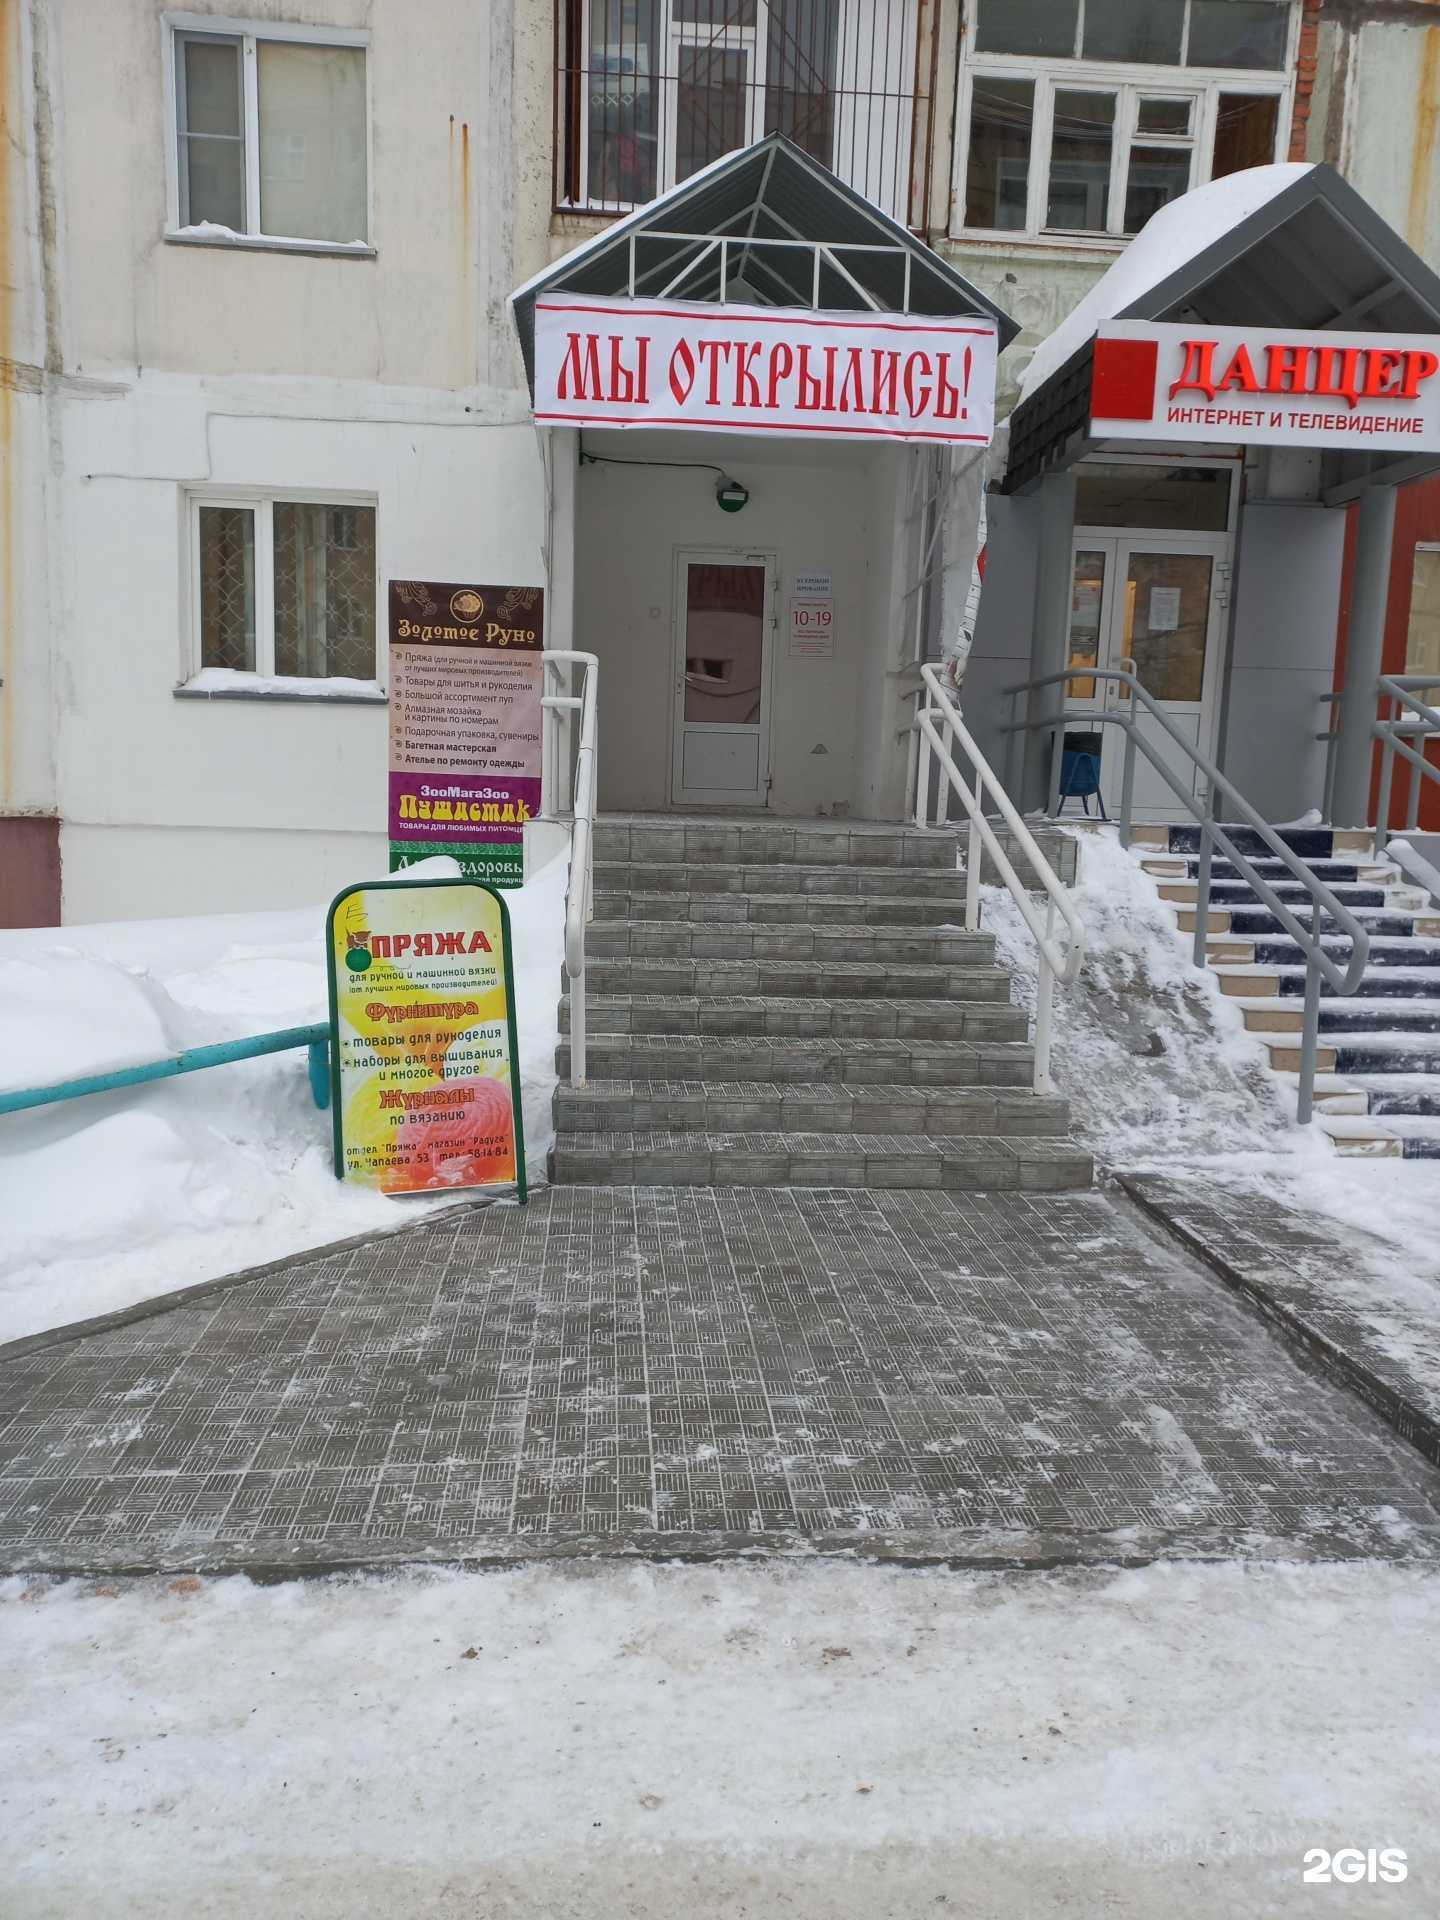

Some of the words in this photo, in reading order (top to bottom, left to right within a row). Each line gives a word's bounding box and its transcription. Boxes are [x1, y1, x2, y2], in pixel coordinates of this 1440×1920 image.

[557, 332, 651, 404] МЫ
[669, 337, 972, 420] ОТКРЫЛИСЬ!
[1168, 340, 1439, 410] ДАНЦЕР
[1167, 407, 1264, 427] ИНТЕРНЕТ
[1269, 412, 1282, 428] И
[1288, 413, 1424, 434] ТЕЛЕВИДЕНИЕ
[793, 611, 832, 626] 10-19
[398, 619, 479, 641] Золотое
[485, 623, 535, 645] Руно
[405, 652, 432, 663] Пряжа
[405, 676, 435, 687] Товары
[437, 679, 452, 688] для
[489, 681, 532, 691] рукоделия
[405, 690, 442, 700] Большой
[444, 693, 497, 704] ассортимент
[405, 704, 445, 714] Алмазная
[412, 714, 447, 724] картины
[462, 718, 498, 726] номерам
[405, 727, 455, 738] Подарочная
[499, 733, 539, 742] сувениры
[405, 741, 444, 751] Багетная
[447, 744, 496, 754] мастерская
[405, 754, 435, 764] Ателье
[437, 757, 448, 765] по
[450, 758, 487, 768] ремонту
[489, 759, 525, 768] одежды
[421, 785, 510, 799] ЗооМагаЗоо
[399, 795, 530, 822] Пушистик
[399, 822, 430, 830] ТОВАРЫ
[431, 823, 446, 831] ДЛЯ
[371, 931, 493, 958] ПРЯЖА
[349, 974, 366, 983] для
[370, 972, 404, 982] ручной
[407, 971, 413, 979] и
[416, 968, 465, 979] машинной
[468, 967, 496, 976] вязки
[365, 985, 393, 993] лучших
[396, 983, 428, 992] мировых
[365, 1001, 479, 1023] Фурнитура
[353, 1036, 405, 1048] товары
[409, 1034, 431, 1046] для
[436, 1029, 501, 1043] рукоделия
[353, 1055, 400, 1067] наборы
[405, 1053, 426, 1066] для
[431, 1049, 503, 1062] вышивания
[379, 1071, 386, 1081] и
[391, 1070, 433, 1080] многое
[438, 1065, 480, 1080] другое
[379, 1088, 475, 1110] Журналы
[390, 1115, 404, 1125] по
[410, 1110, 465, 1124] вязанию
[428, 1139, 465, 1149] магазин
[417, 1153, 429, 1163] 53
